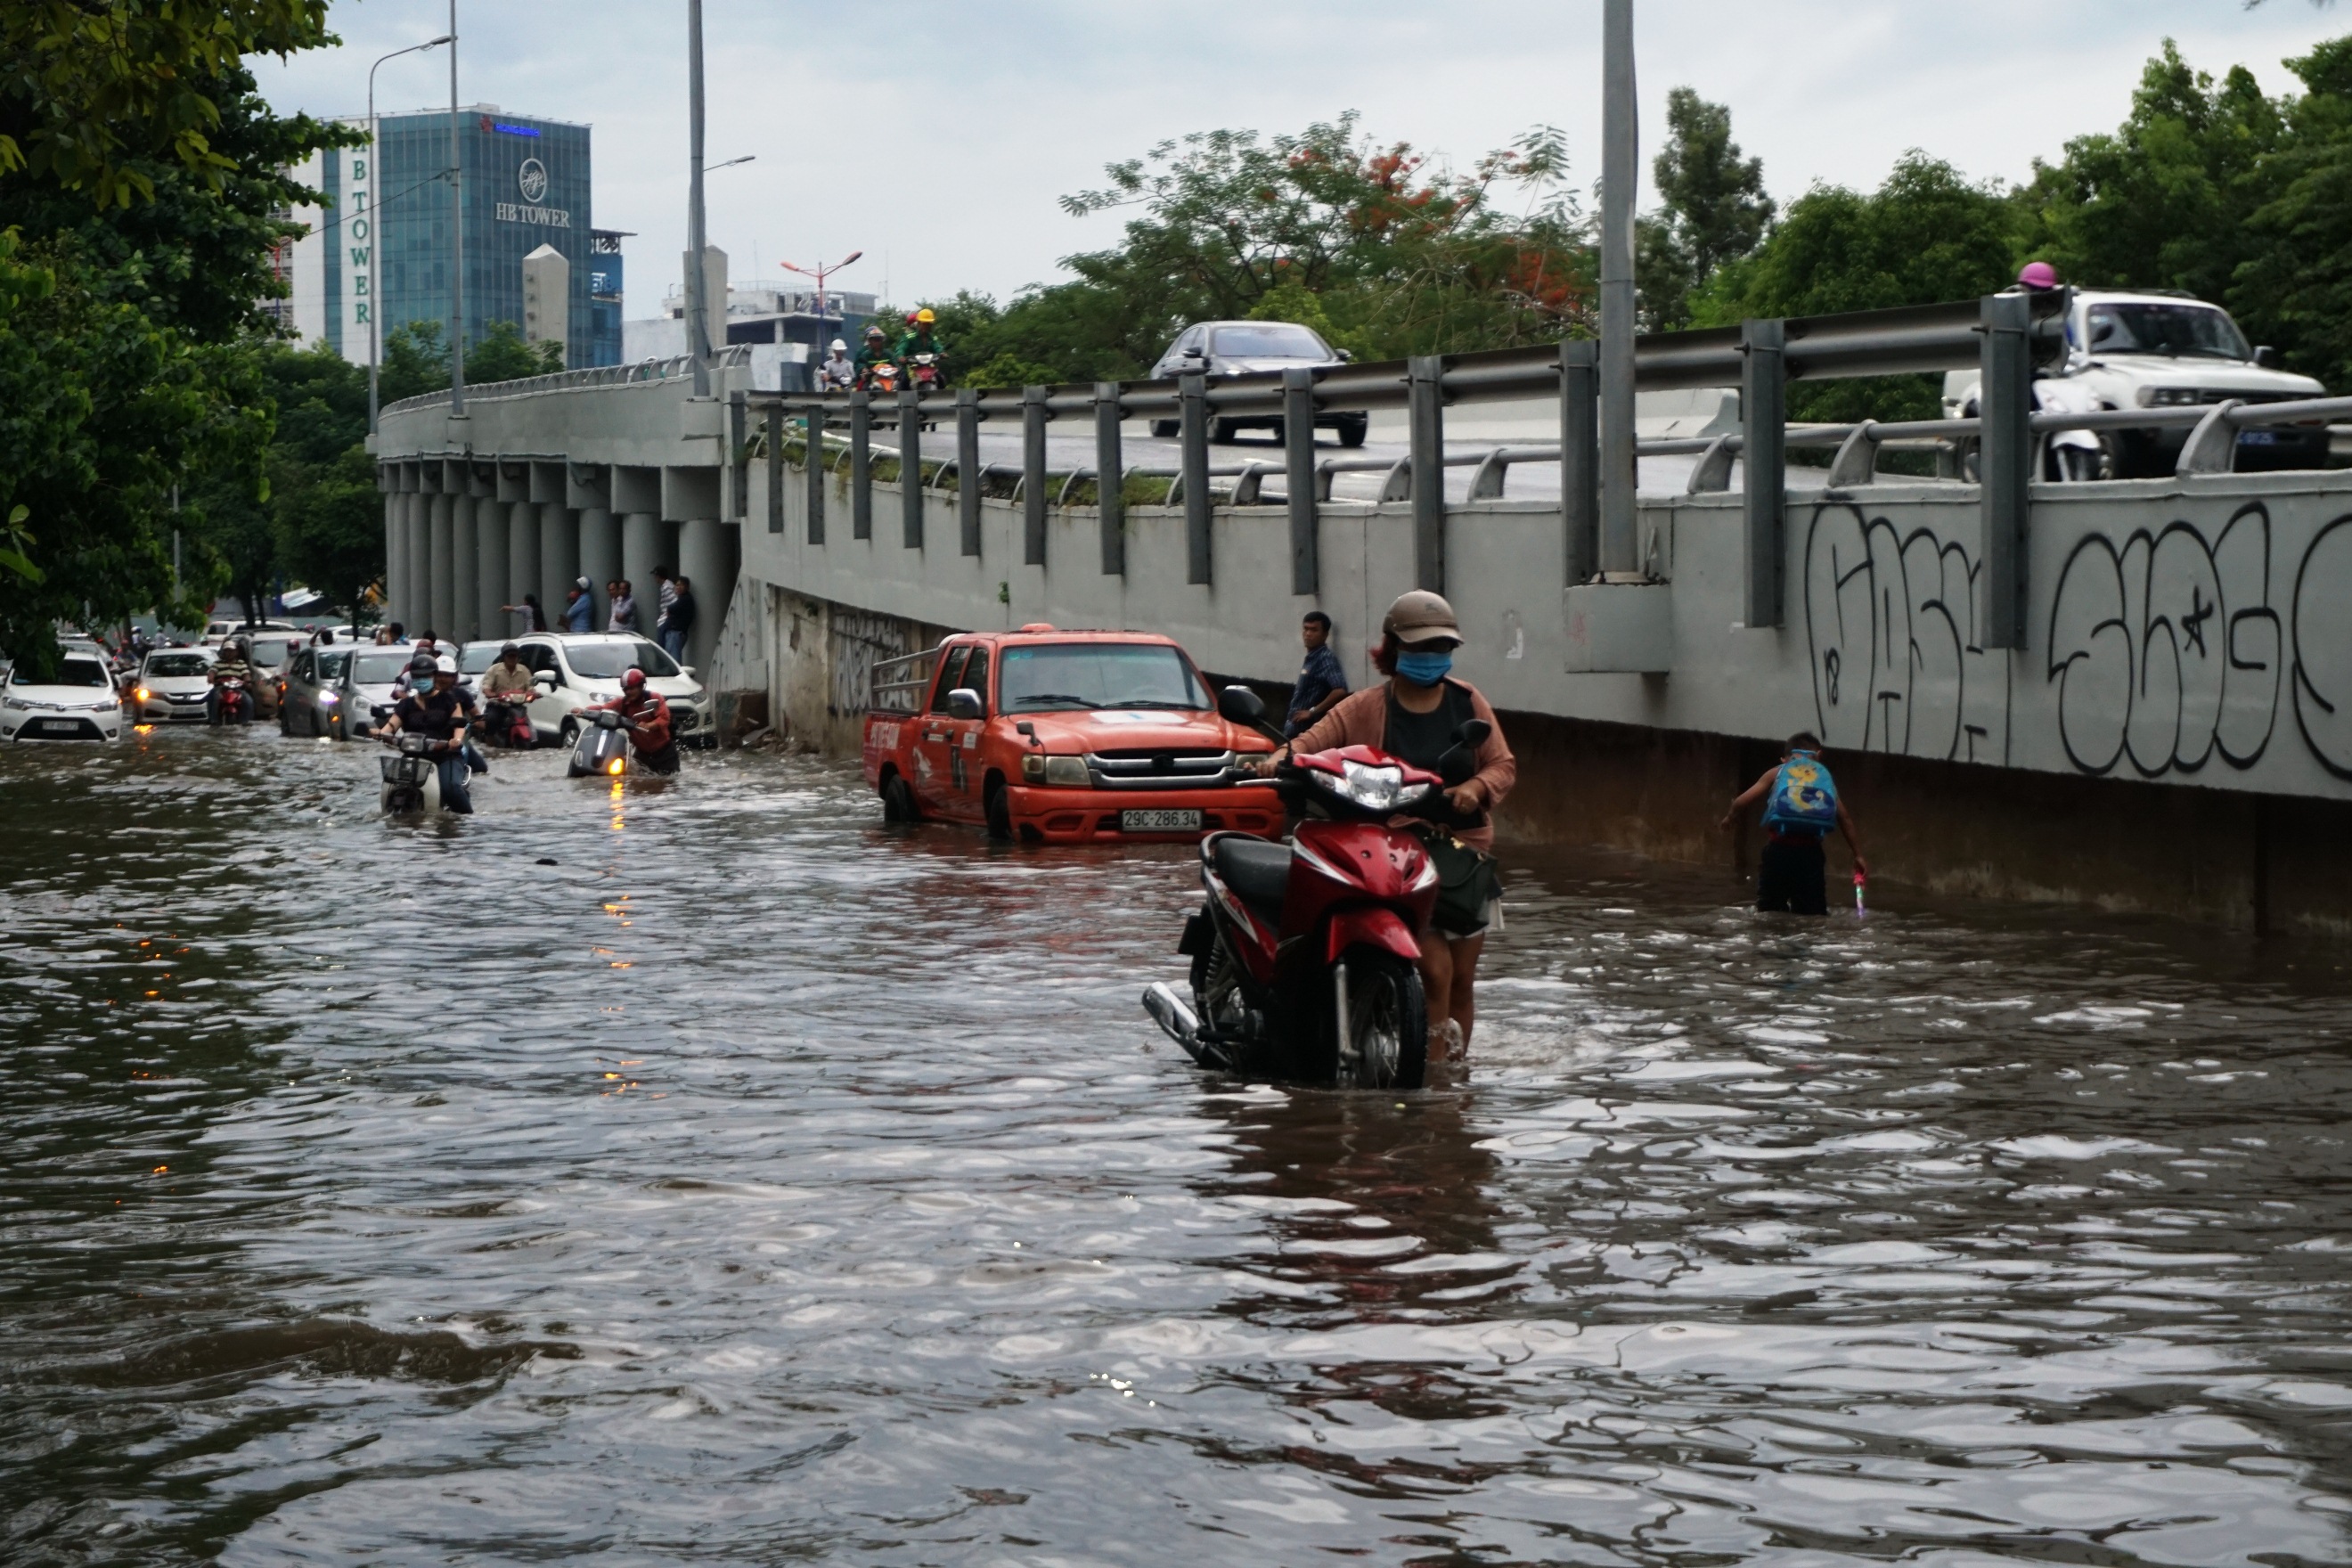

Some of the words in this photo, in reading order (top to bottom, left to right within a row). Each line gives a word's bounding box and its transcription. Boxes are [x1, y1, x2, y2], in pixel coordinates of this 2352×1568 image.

[495, 202, 518, 222] HB
[518, 205, 571, 228] TOWER
[350, 192, 371, 324] TOWER
